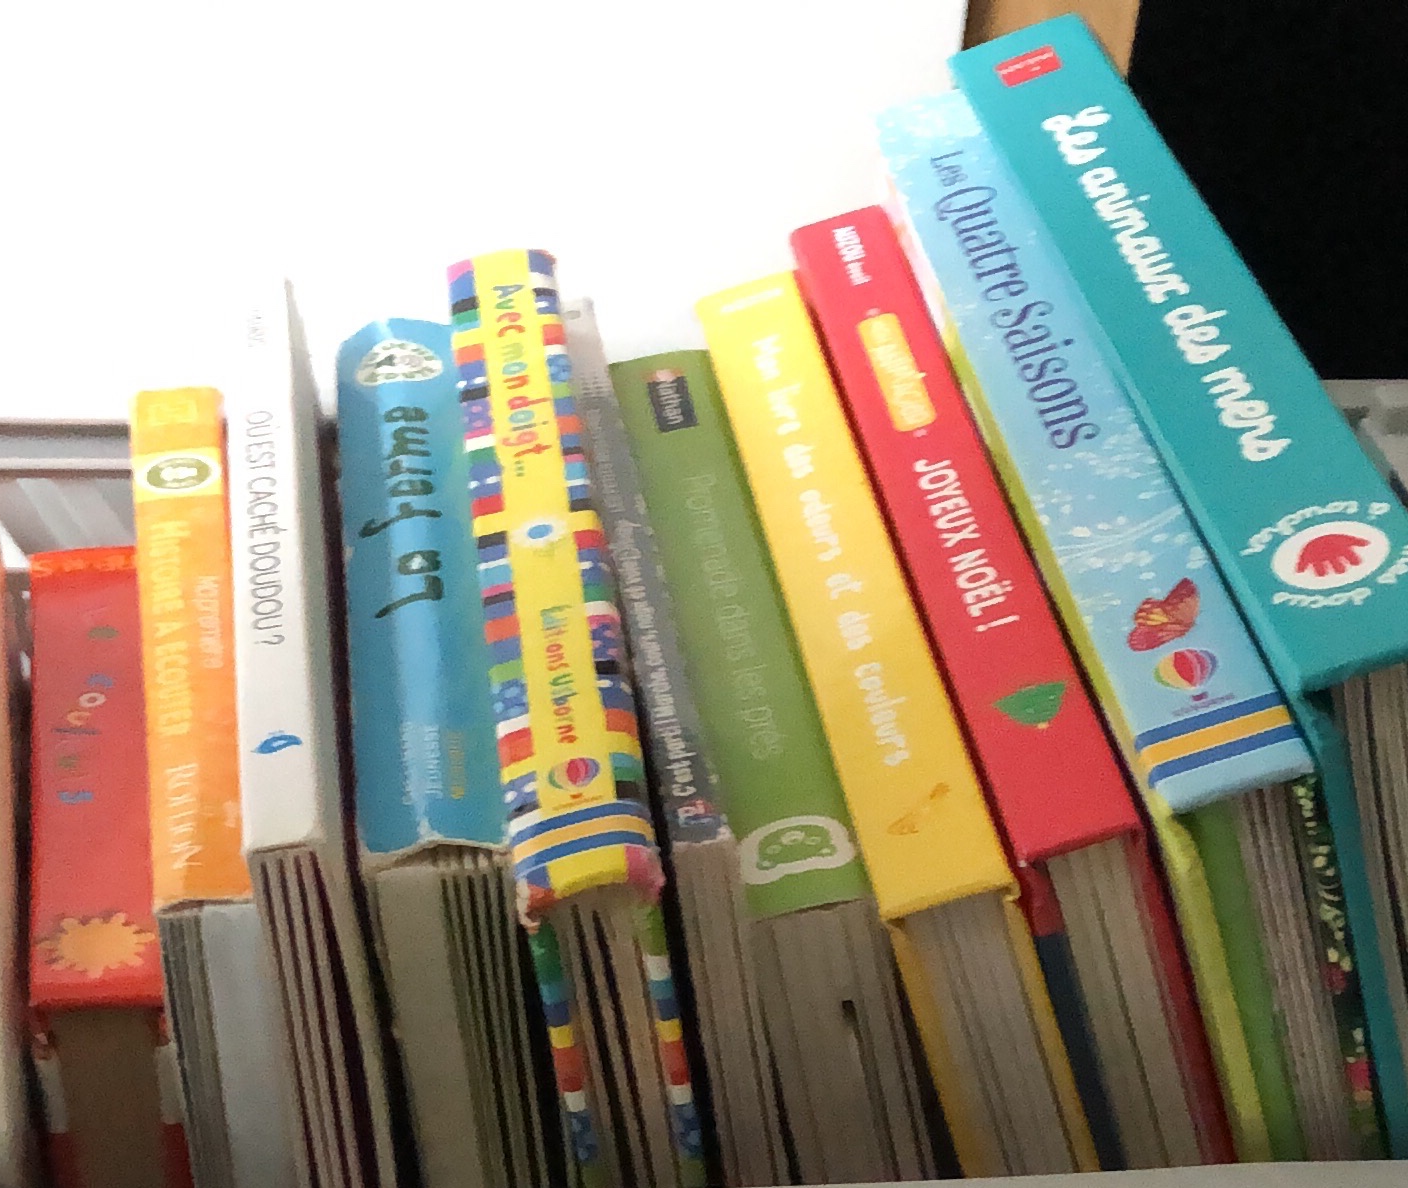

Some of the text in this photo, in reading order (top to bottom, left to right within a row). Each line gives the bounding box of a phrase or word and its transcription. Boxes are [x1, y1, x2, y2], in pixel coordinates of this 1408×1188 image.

[929, 149, 970, 189] Les
[929, 185, 1029, 303] Quatre
[493, 284, 526, 338] Avec
[1041, 104, 1293, 464] Les animaux des mers
[499, 342, 530, 390] mon
[992, 300, 1101, 452] Saisons
[655, 378, 684, 425] Nathan
[245, 440, 276, 470] EST
[358, 406, 443, 538] ferme
[783, 443, 816, 479] des
[246, 476, 288, 539] CACHÉ
[799, 489, 842, 562] odeurs
[912, 459, 982, 548] JOYEUX
[948, 548, 1013, 618] NOËL
[247, 540, 284, 631] DOUDOU
[375, 549, 445, 619] La
[682, 473, 787, 761] Promenade dans les prés
[825, 573, 864, 600] et
[838, 611, 875, 651] des
[854, 662, 911, 767] couleurs
